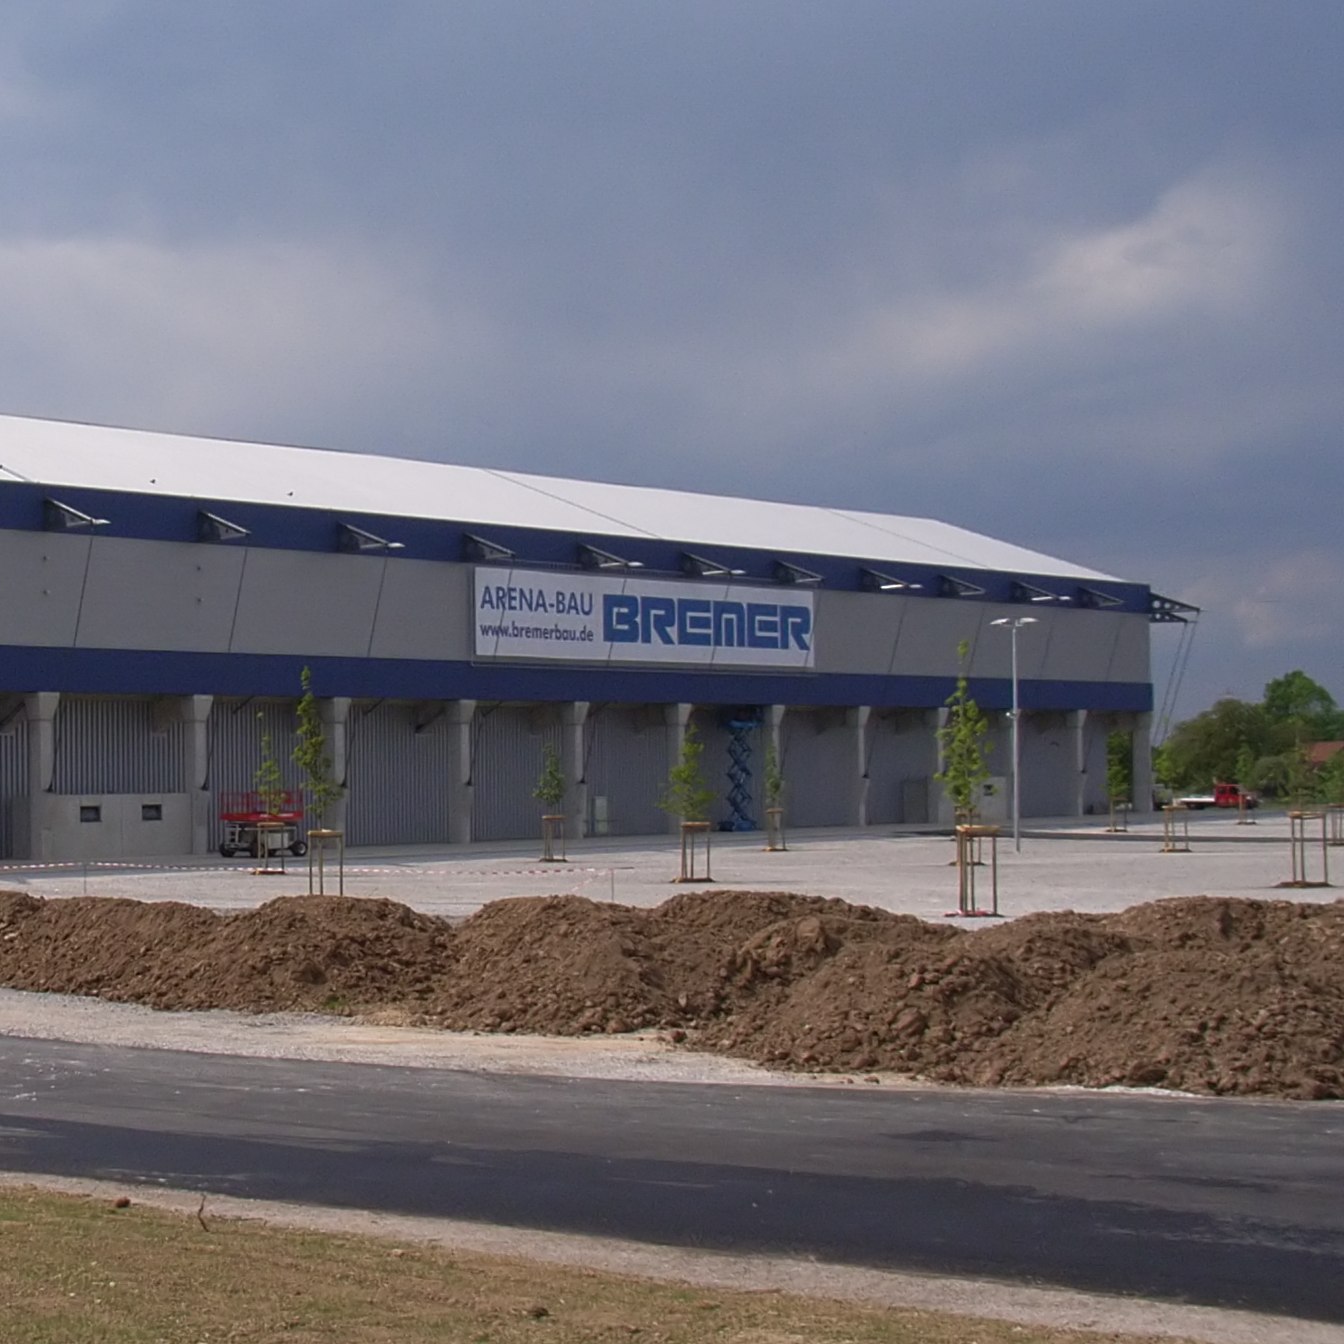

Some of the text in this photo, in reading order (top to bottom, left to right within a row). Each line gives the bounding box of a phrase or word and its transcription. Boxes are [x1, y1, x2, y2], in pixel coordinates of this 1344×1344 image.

[480, 585, 593, 615] ARENA-BAU
[480, 620, 594, 641] www.bremerbau.de
[603, 594, 812, 651] BREMER
